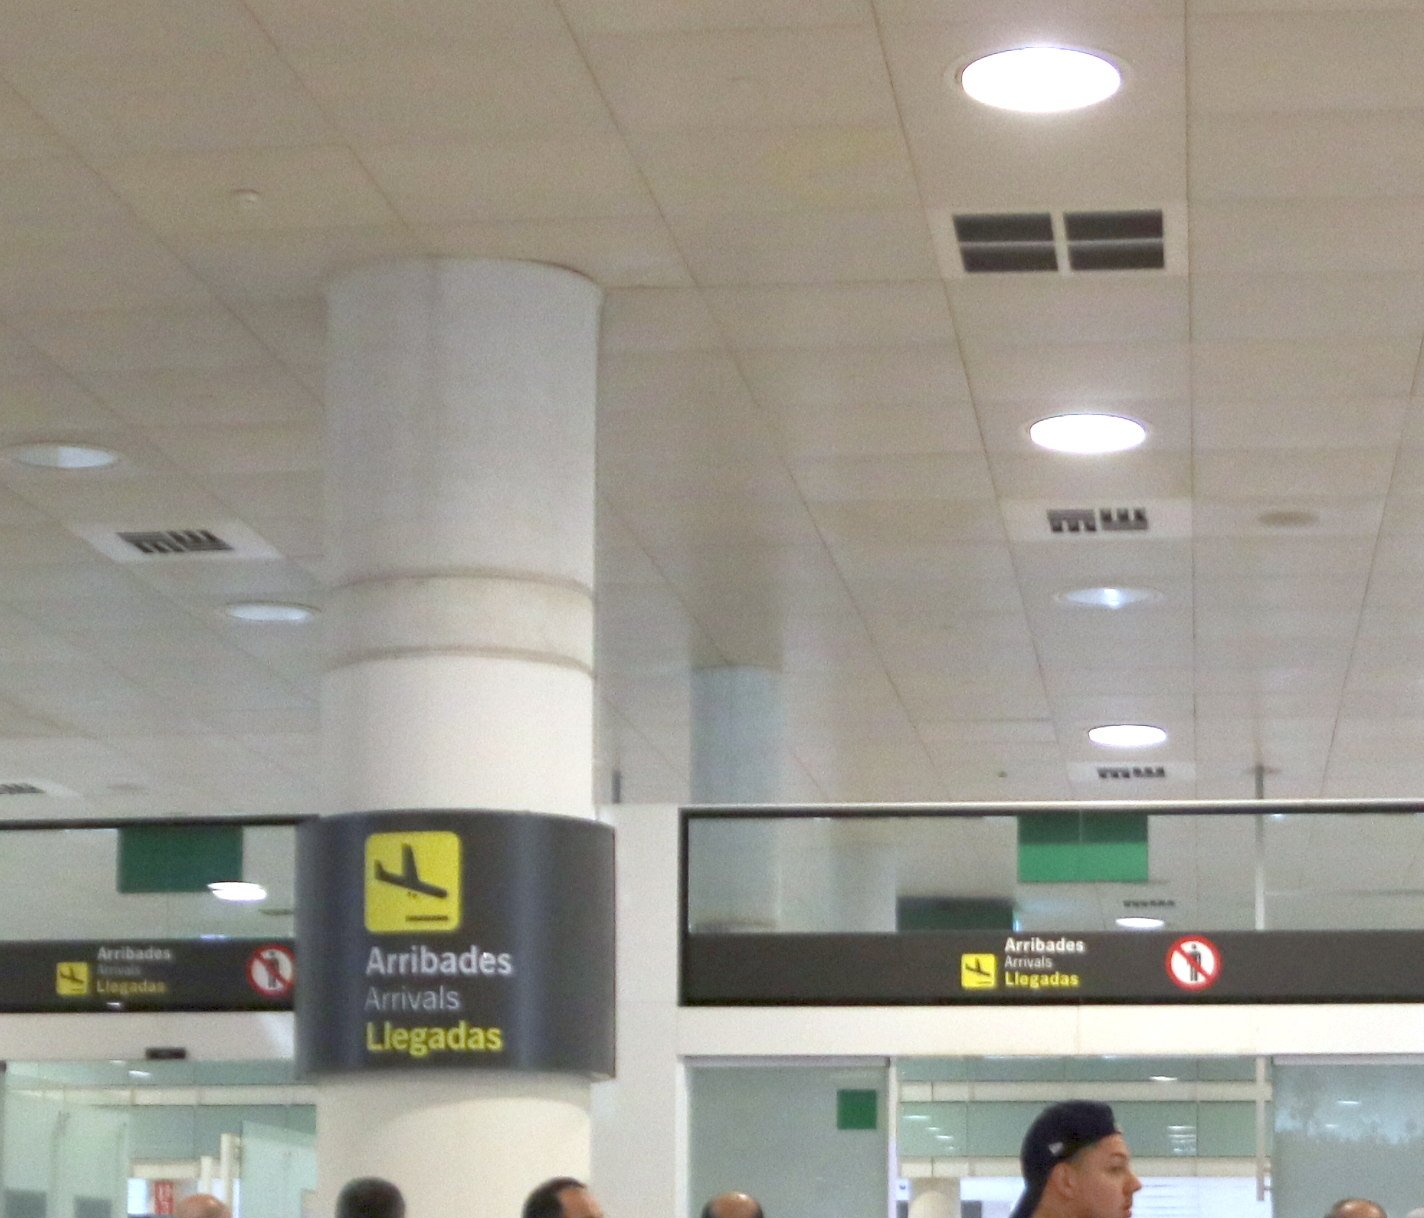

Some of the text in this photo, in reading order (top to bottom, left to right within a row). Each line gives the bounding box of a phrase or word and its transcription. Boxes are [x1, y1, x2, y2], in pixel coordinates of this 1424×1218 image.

[1005, 937, 1085, 953] Arribades
[97, 946, 171, 961] Arribades
[366, 945, 514, 975] Arribades
[1004, 955, 1054, 968] Arrivals
[96, 980, 168, 995] Llegadas
[1005, 971, 1080, 988] Llegadas
[364, 985, 461, 1011] Arrivals
[366, 1020, 503, 1058] Llegadas
